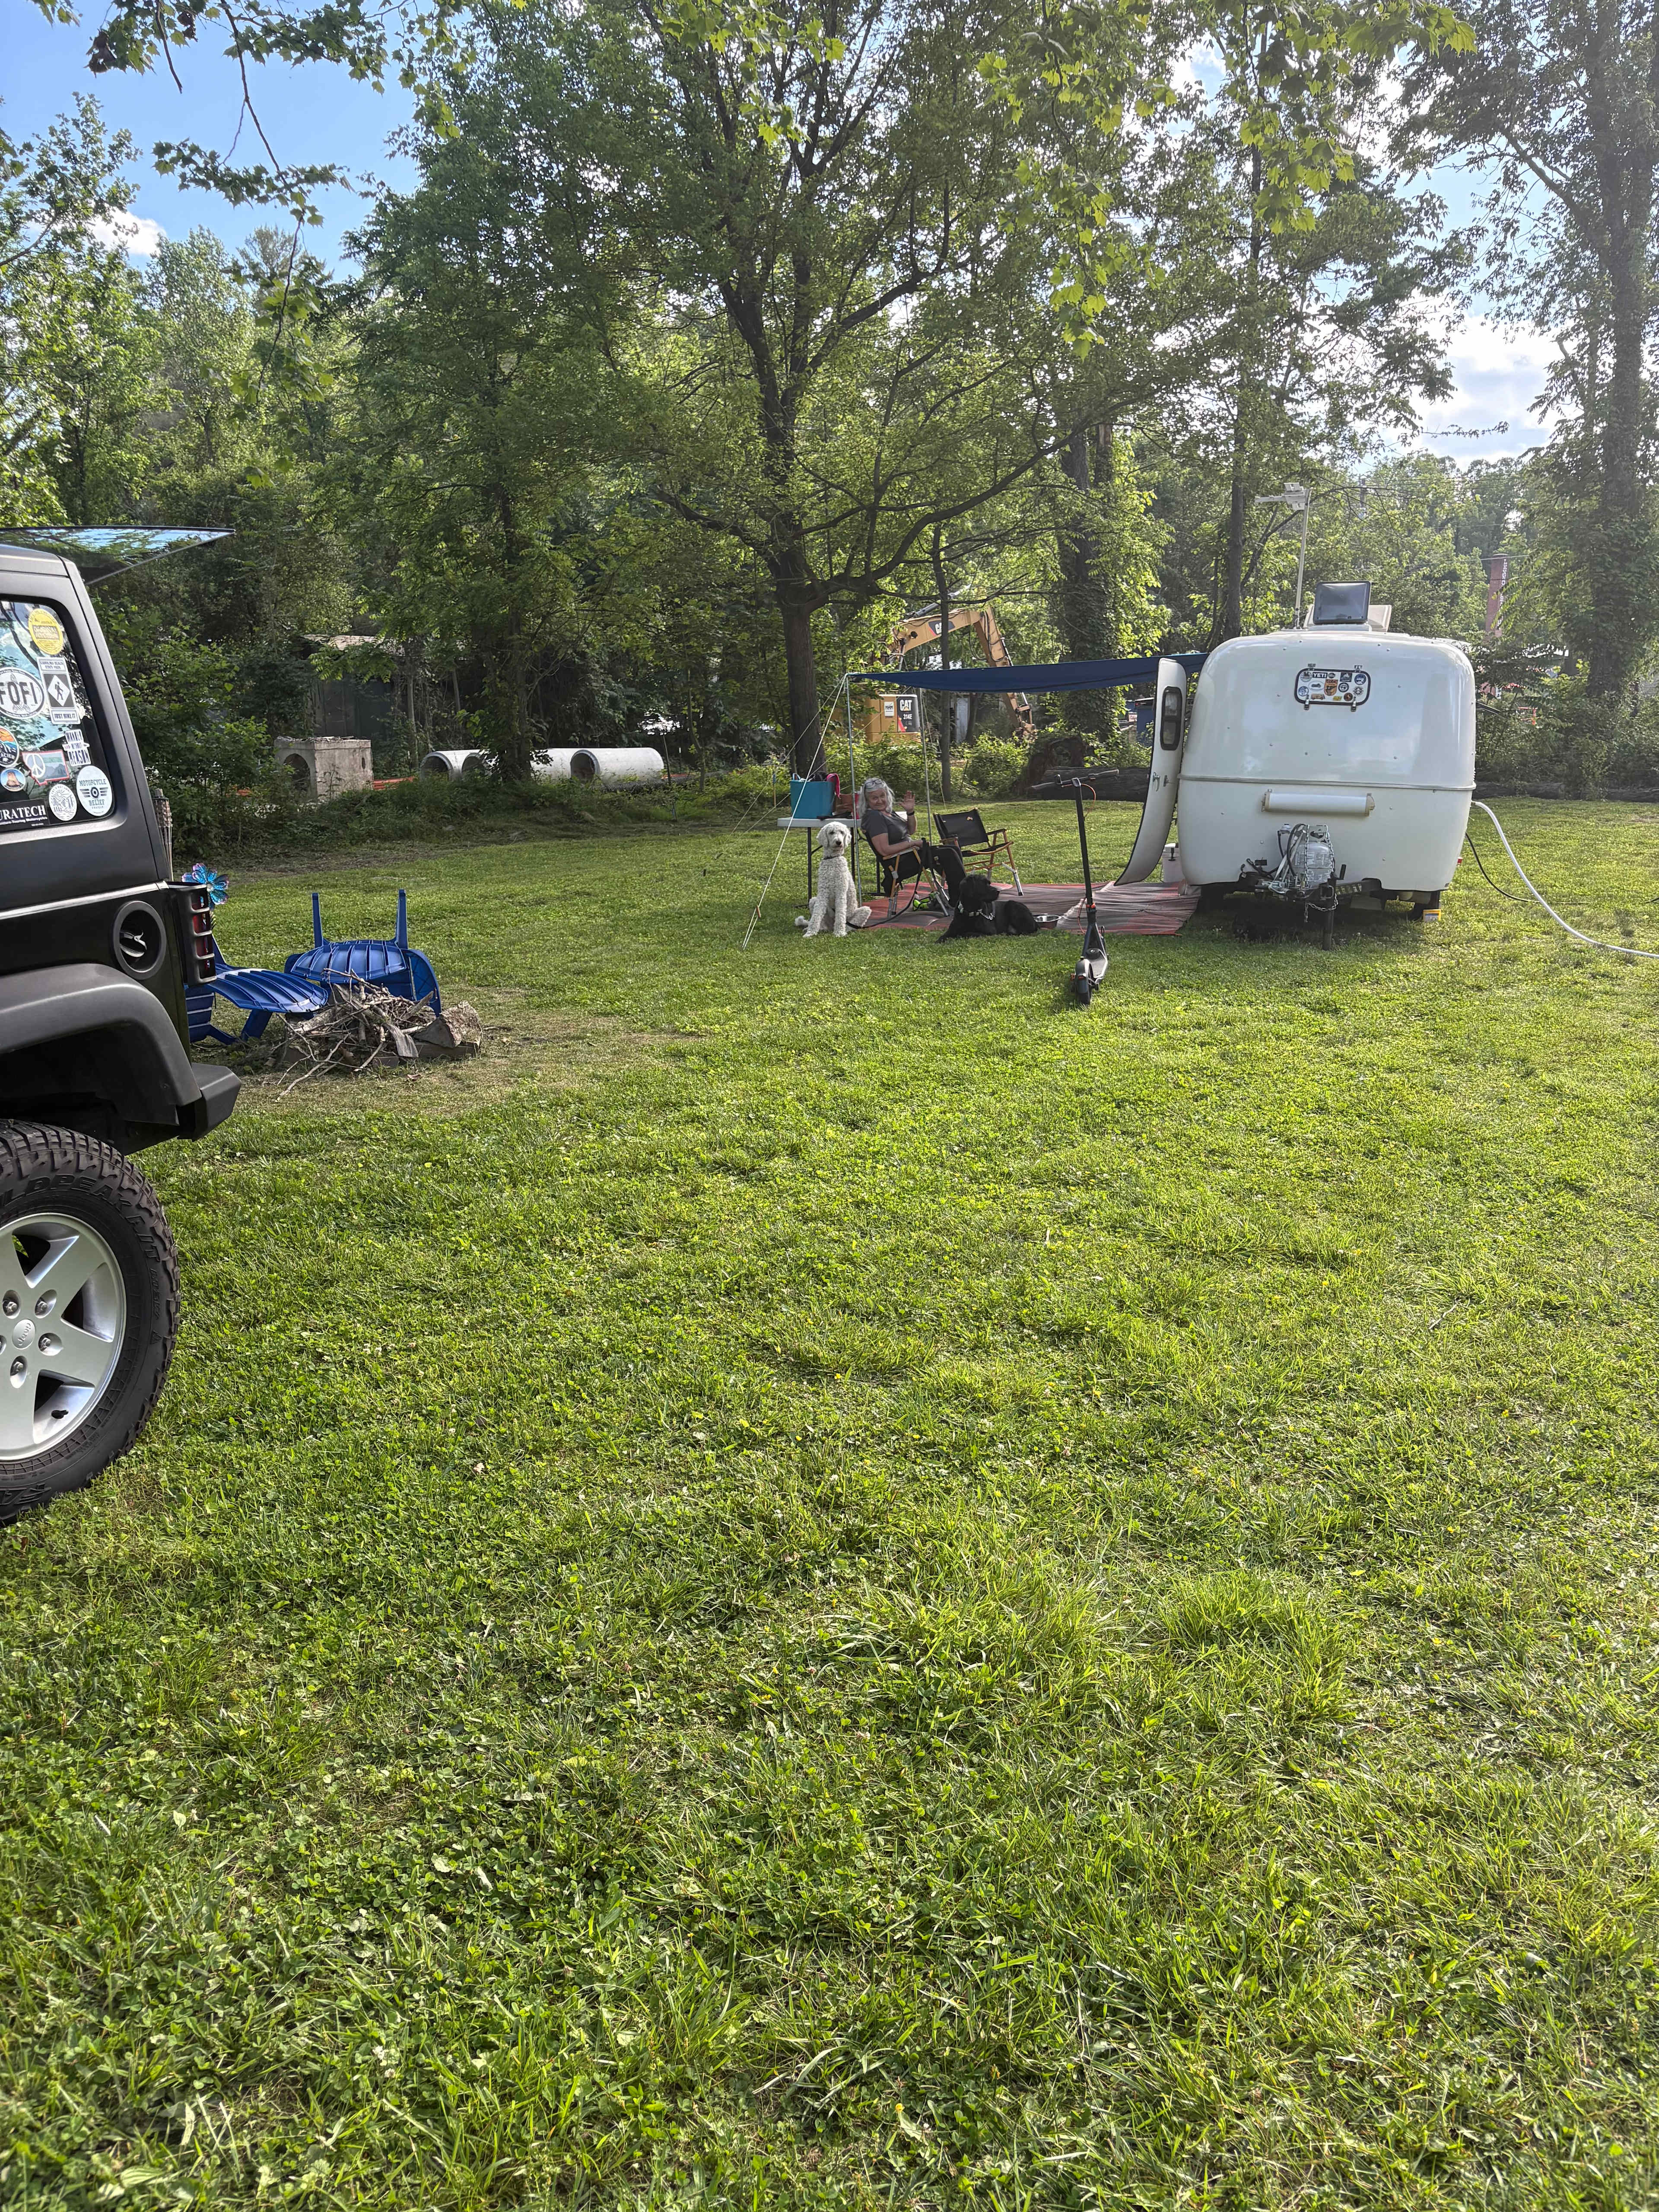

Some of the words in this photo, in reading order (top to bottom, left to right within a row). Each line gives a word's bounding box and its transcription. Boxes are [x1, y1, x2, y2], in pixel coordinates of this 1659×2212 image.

[899, 699, 912, 711] CAT
[68, 750, 90, 765] REASON
[17, 1322, 32, 1346] Jeep
